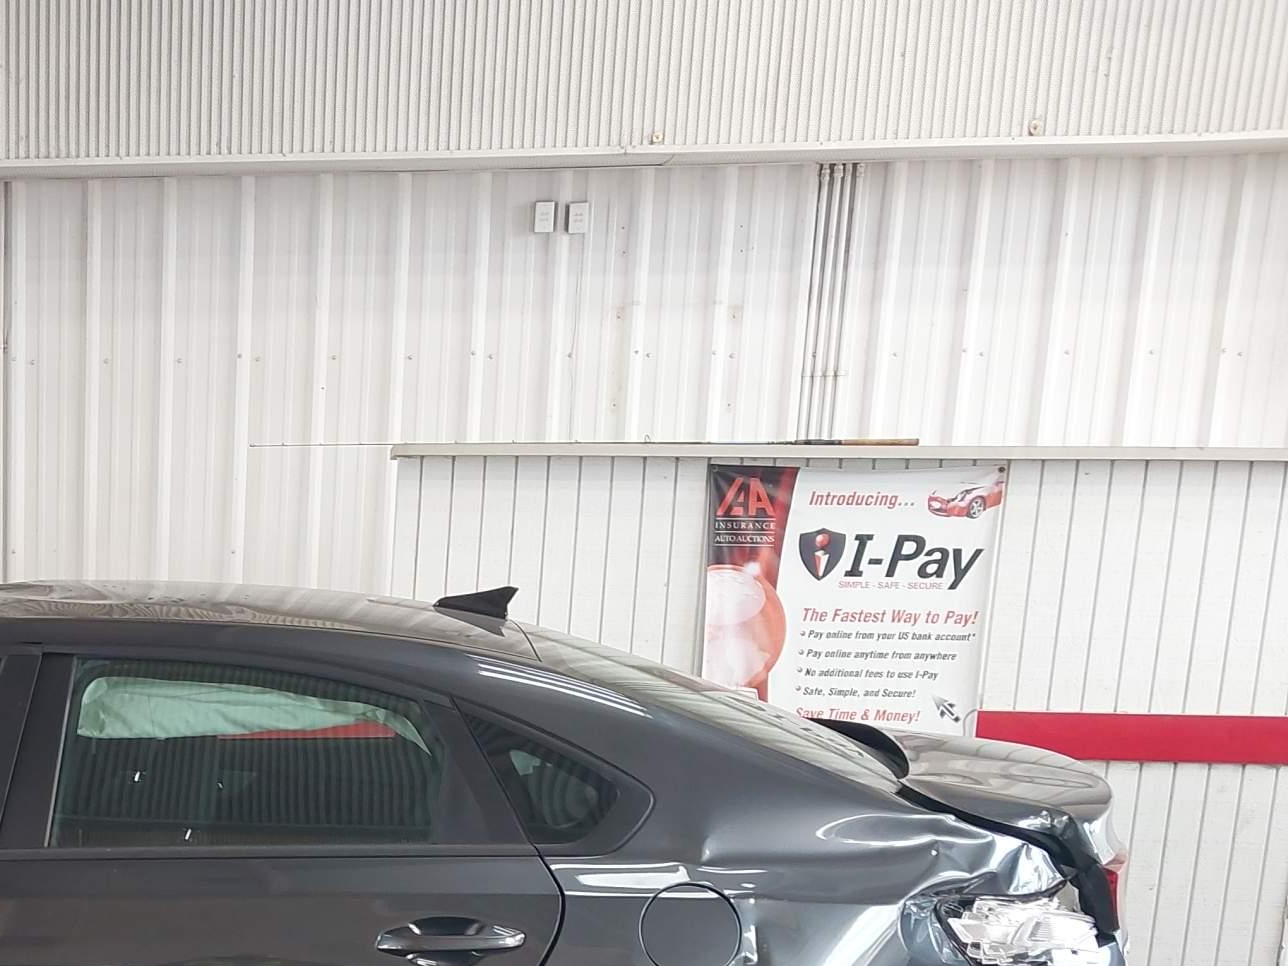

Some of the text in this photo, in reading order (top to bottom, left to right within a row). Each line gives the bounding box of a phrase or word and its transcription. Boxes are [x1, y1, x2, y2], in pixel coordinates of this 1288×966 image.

[809, 490, 915, 510] Introducing...
[715, 521, 776, 530] INSURANCE
[714, 534, 775, 544] AUTO AUCTIONS
[843, 533, 985, 591] I-Pay
[838, 580, 870, 589] SIMPLE
[877, 581, 901, 590] SAFE
[907, 581, 944, 590] SECURE
[802, 607, 979, 628] The Fastest Way to Pay!
[807, 629, 824, 640] Pay
[826, 629, 853, 639] online
[854, 630, 875, 640] from
[876, 632, 897, 642] your
[898, 631, 910, 640] US
[911, 631, 933, 641] bank
[806, 648, 958, 663] Pay online anytime from anywhere
[804, 667, 939, 681] No additional fees to use I-Pay
[802, 686, 917, 699] Safe, Simple, and Secure!
[796, 706, 921, 724] Save Time & Money!
